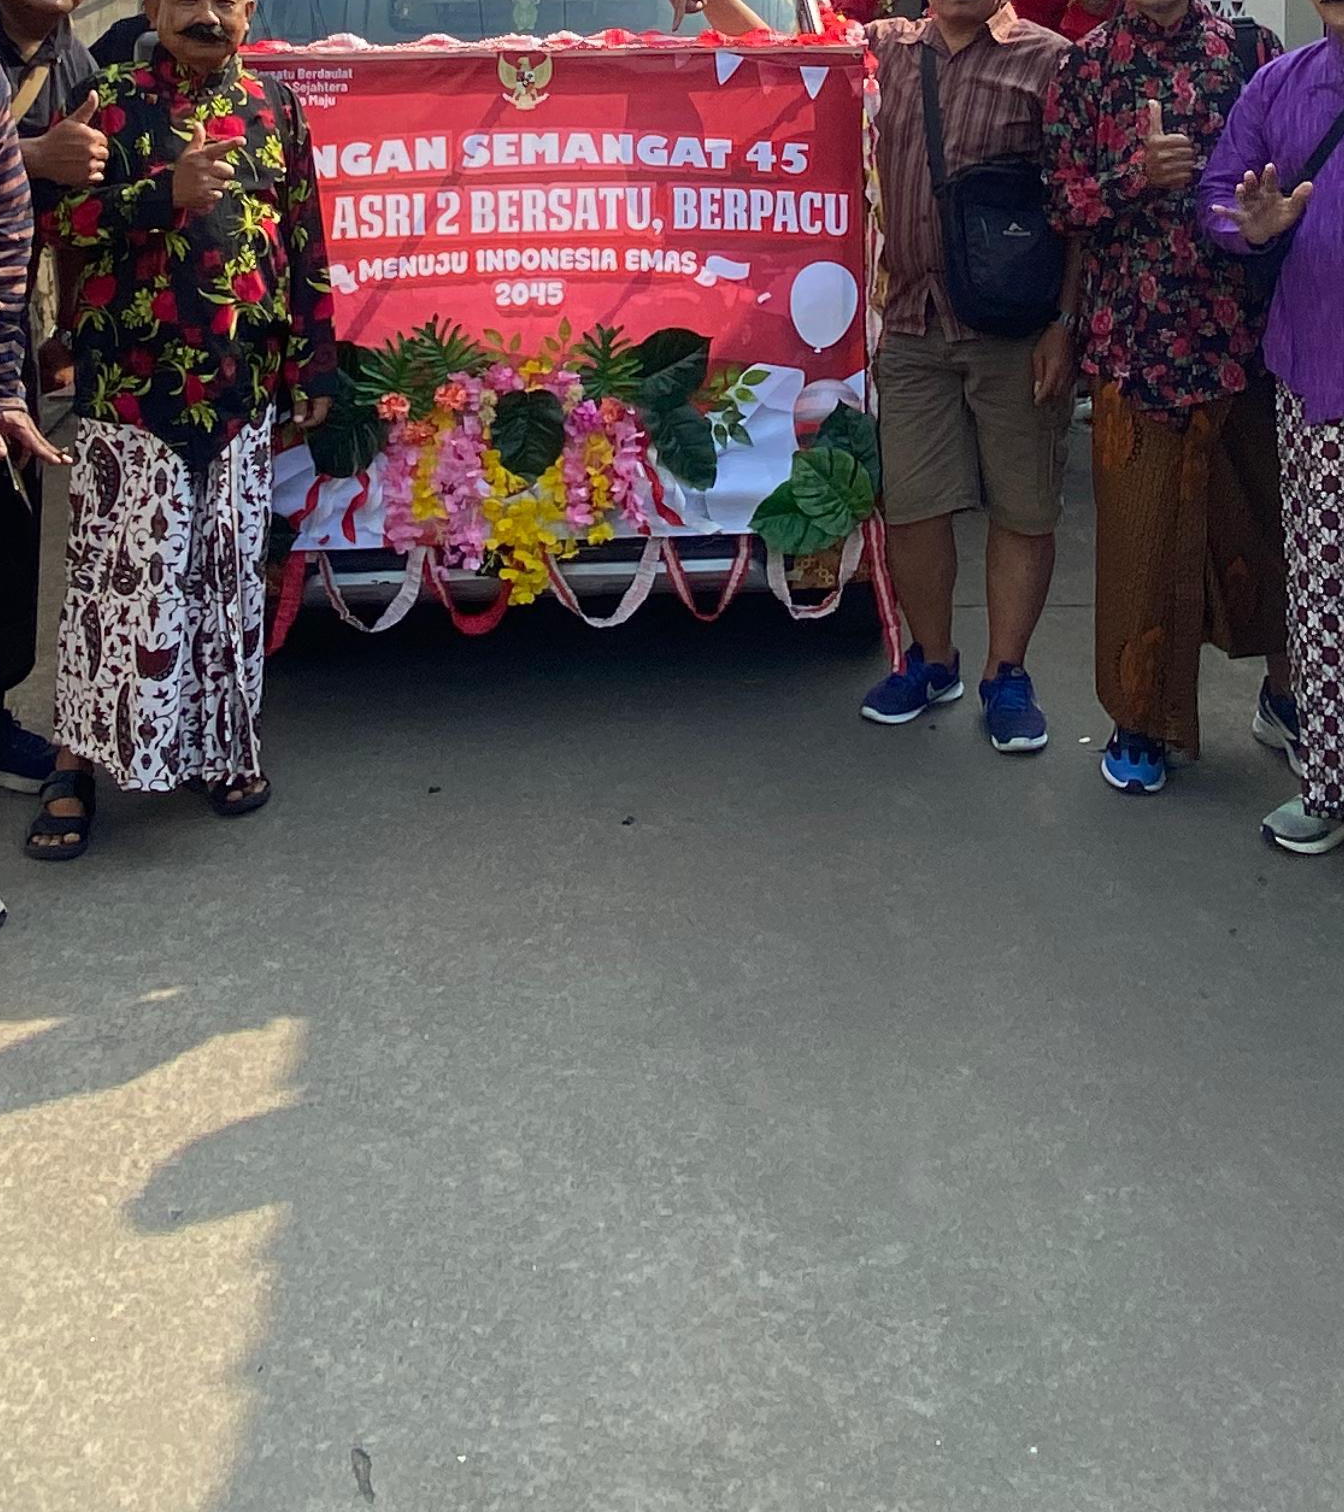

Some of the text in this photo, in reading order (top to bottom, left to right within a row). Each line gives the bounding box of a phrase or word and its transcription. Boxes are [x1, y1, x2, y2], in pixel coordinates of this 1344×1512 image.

[297, 68, 353, 79] Berdaulat
[291, 80, 349, 95] Sejahtera
[308, 94, 336, 108] Maju
[462, 132, 732, 169] SEMANGAT
[745, 140, 809, 174] 45
[331, 187, 849, 240] ASRI 2 BERSATU, BERPACU
[358, 247, 698, 283] MENUJU INDONESIA EMAS
[495, 281, 565, 306] 2045
